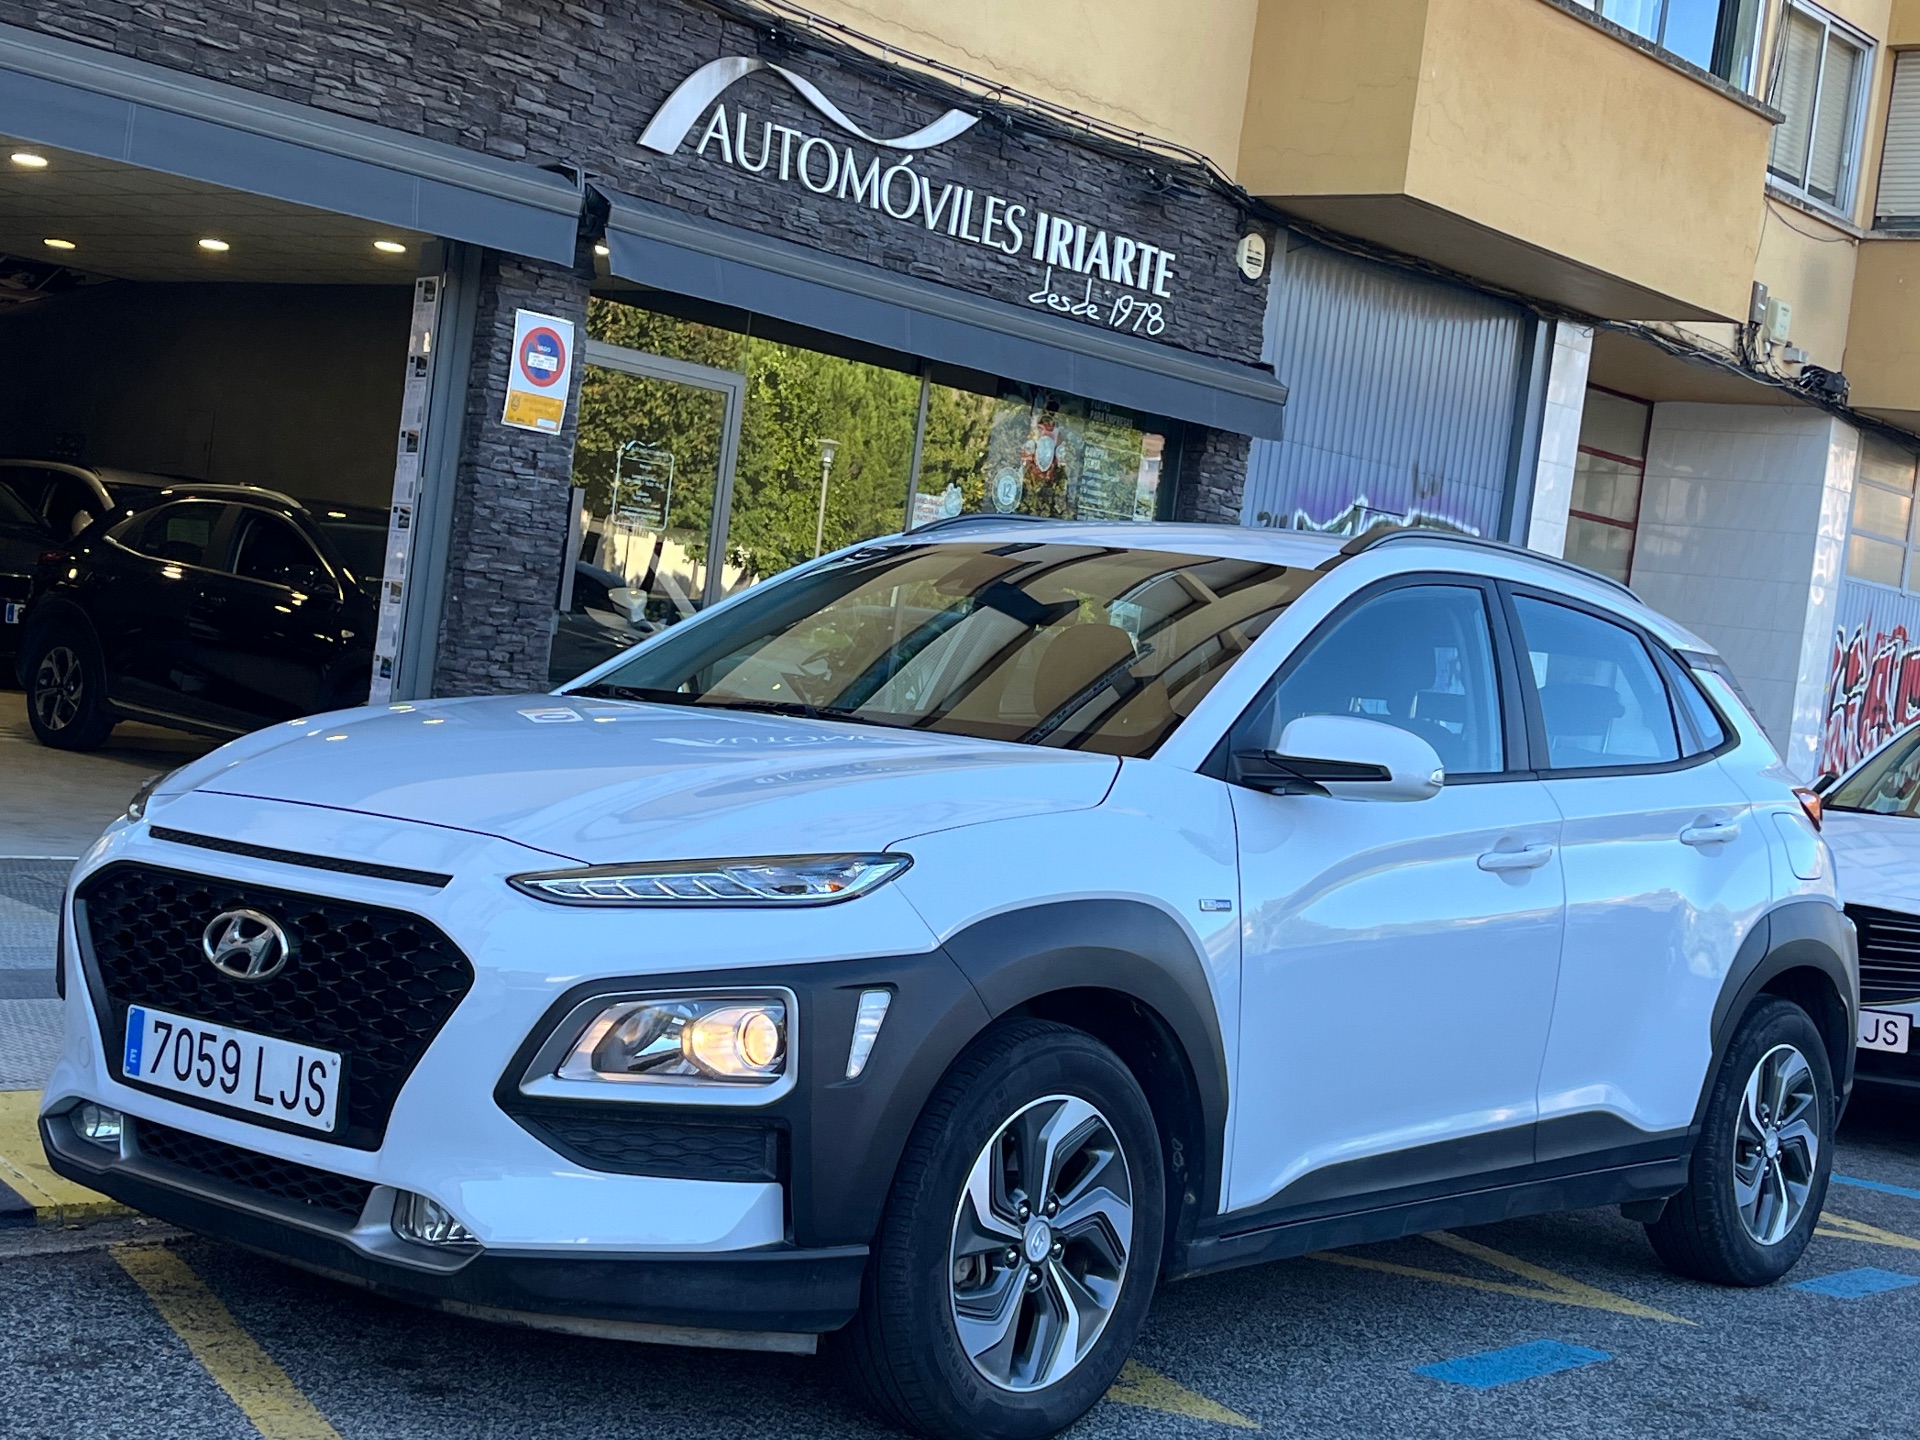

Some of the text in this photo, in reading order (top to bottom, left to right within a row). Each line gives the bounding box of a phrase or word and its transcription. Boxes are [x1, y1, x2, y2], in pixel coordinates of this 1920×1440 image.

[697, 103, 1176, 298] AUTOMÓVILES IRIARTE
[1028, 266, 1165, 336] desde 1978
[129, 1049, 137, 1064] E
[1857, 1018, 1899, 1046] JS
[150, 1020, 327, 1117] 7059 LJS
